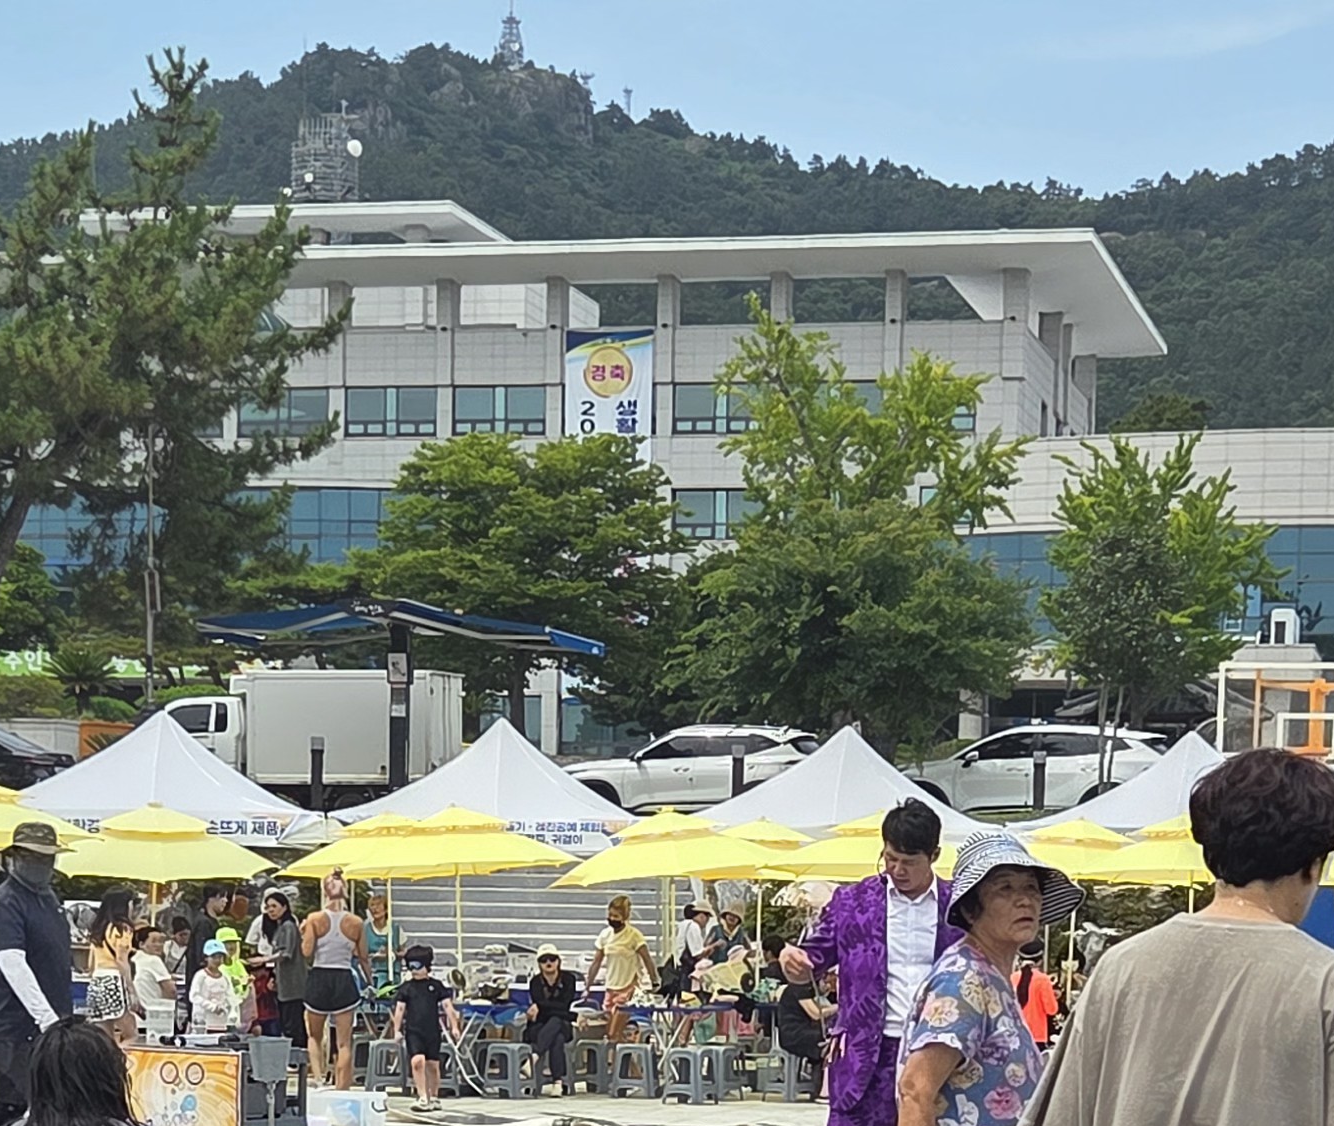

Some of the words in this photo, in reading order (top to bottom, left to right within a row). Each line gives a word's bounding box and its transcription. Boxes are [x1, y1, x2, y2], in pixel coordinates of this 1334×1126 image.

[591, 364, 625, 381] 경축
[251, 821, 279, 836] 제품
[551, 834, 583, 845] 귀걸이
